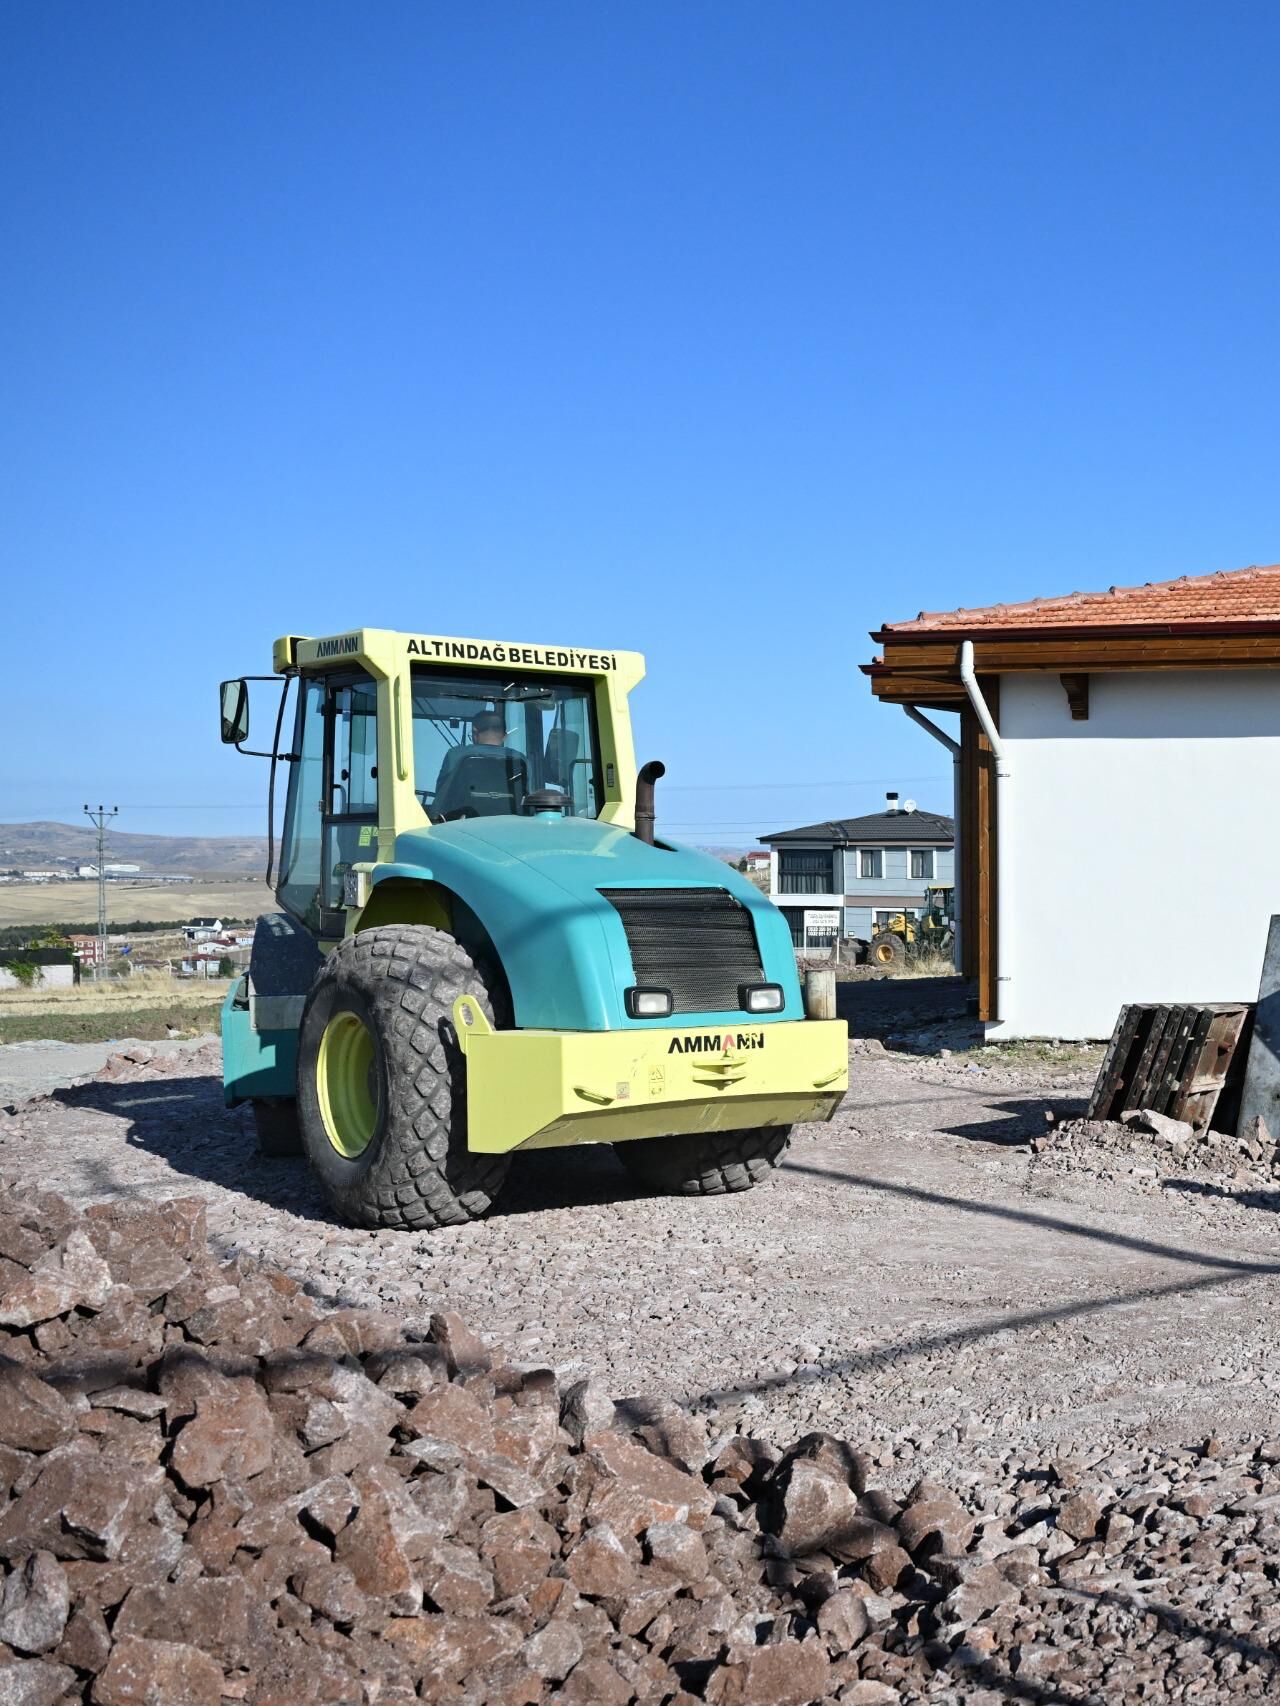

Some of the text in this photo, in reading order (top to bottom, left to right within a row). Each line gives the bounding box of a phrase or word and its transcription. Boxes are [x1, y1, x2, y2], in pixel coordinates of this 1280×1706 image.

[316, 636, 358, 658] AMMANN
[406, 639, 617, 670] ALTINDAĞ BELEDİYESİ
[668, 1033, 764, 1054] AMMANN
